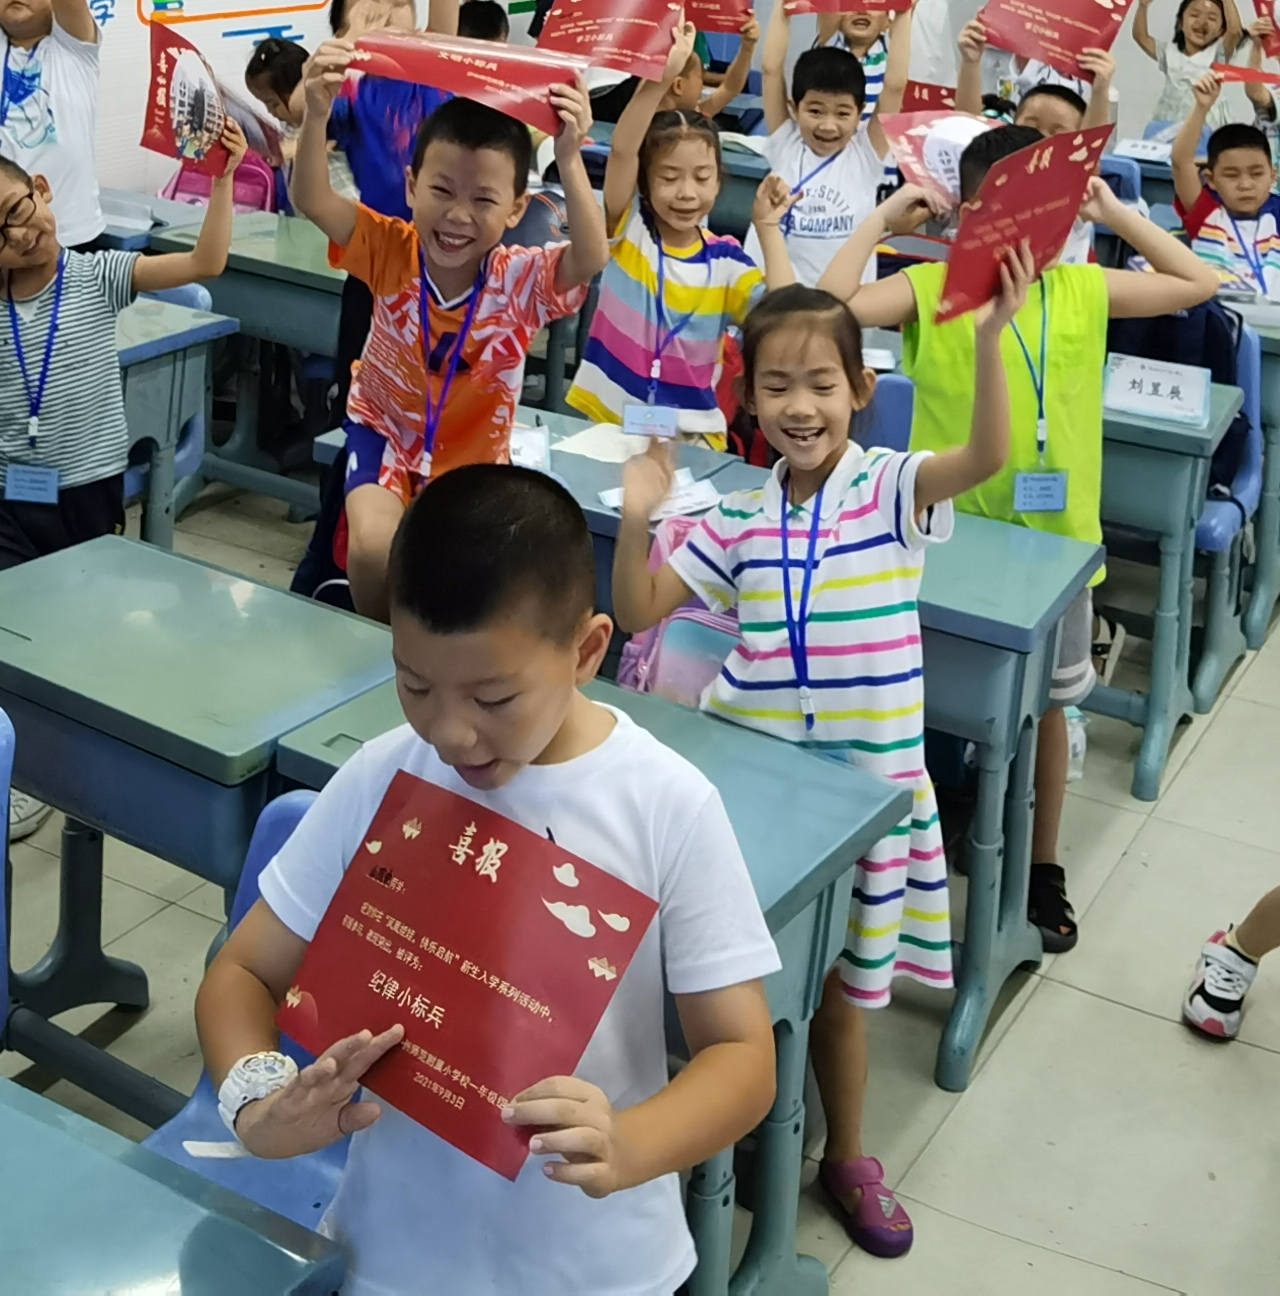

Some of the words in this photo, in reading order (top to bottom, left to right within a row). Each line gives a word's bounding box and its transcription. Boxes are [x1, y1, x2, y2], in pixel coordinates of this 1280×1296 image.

[800, 213, 855, 233] COMPANY
[448, 821, 509, 884] 喜报
[367, 968, 447, 1031] 纪律小标兵
